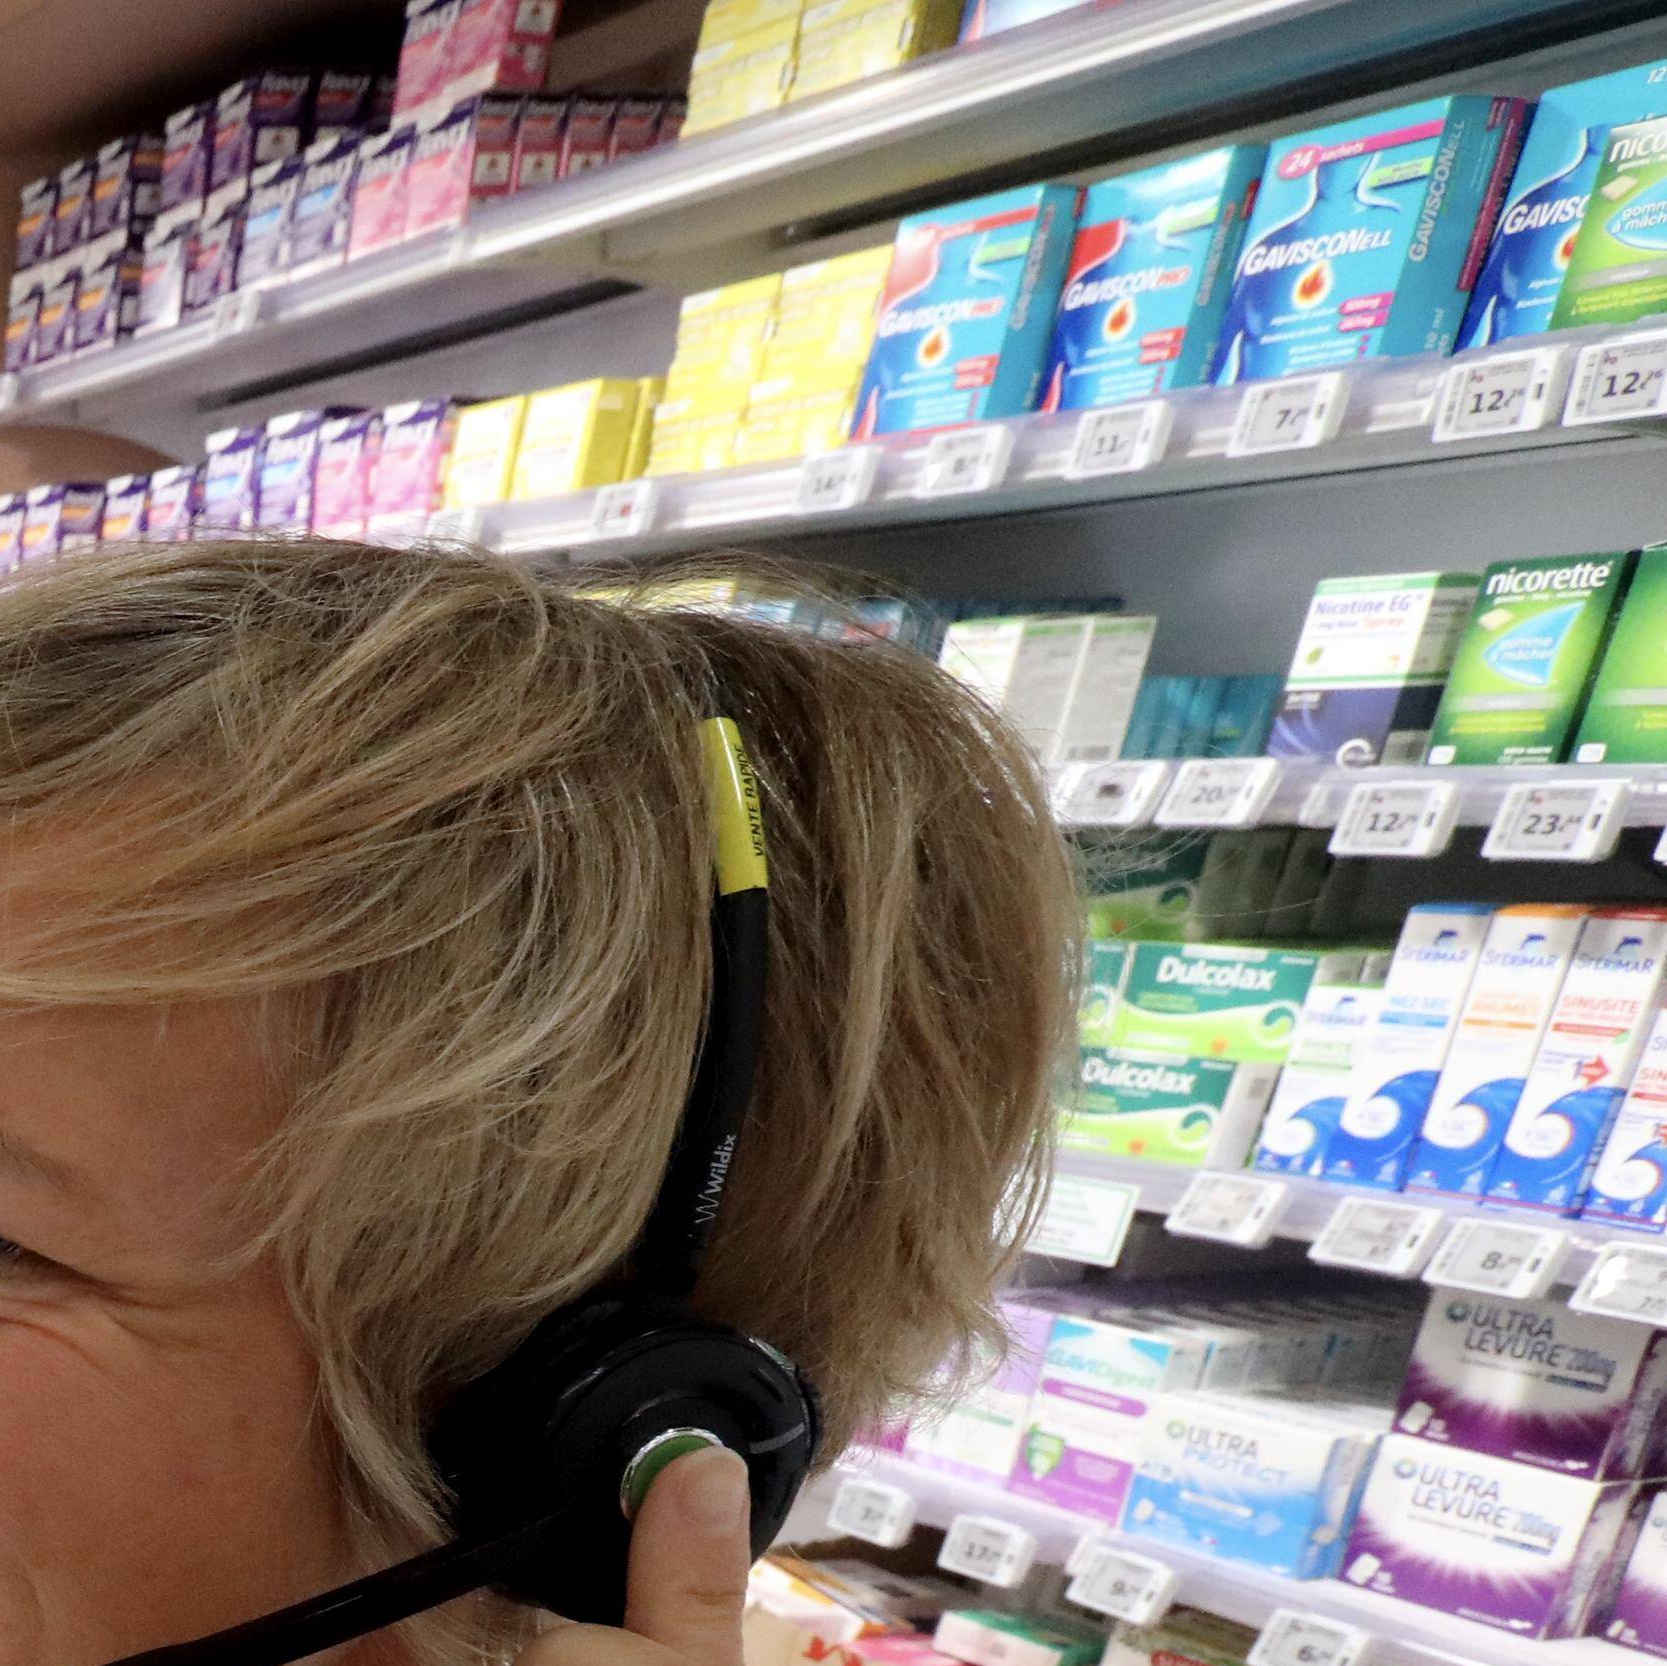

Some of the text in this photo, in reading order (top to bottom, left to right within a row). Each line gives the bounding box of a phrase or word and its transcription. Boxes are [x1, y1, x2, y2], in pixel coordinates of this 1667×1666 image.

[1286, 148, 1314, 172] 24
[1243, 228, 1393, 276] GAVISCONELL
[1485, 562, 1612, 596] nicorette
[734, 742, 766, 858] VENTE RAPIDE
[1155, 955, 1277, 991] Dulcolax
[1561, 994, 1640, 1014] SINUSITE
[703, 1132, 737, 1198] Wildix
[1471, 1303, 1555, 1341] ULTRA
[1464, 1330, 1564, 1369] LEVURE
[1186, 1424, 1261, 1461] ULTRA
[1419, 1462, 1501, 1503] ULTRA
[1410, 1485, 1513, 1530] LEVURE
